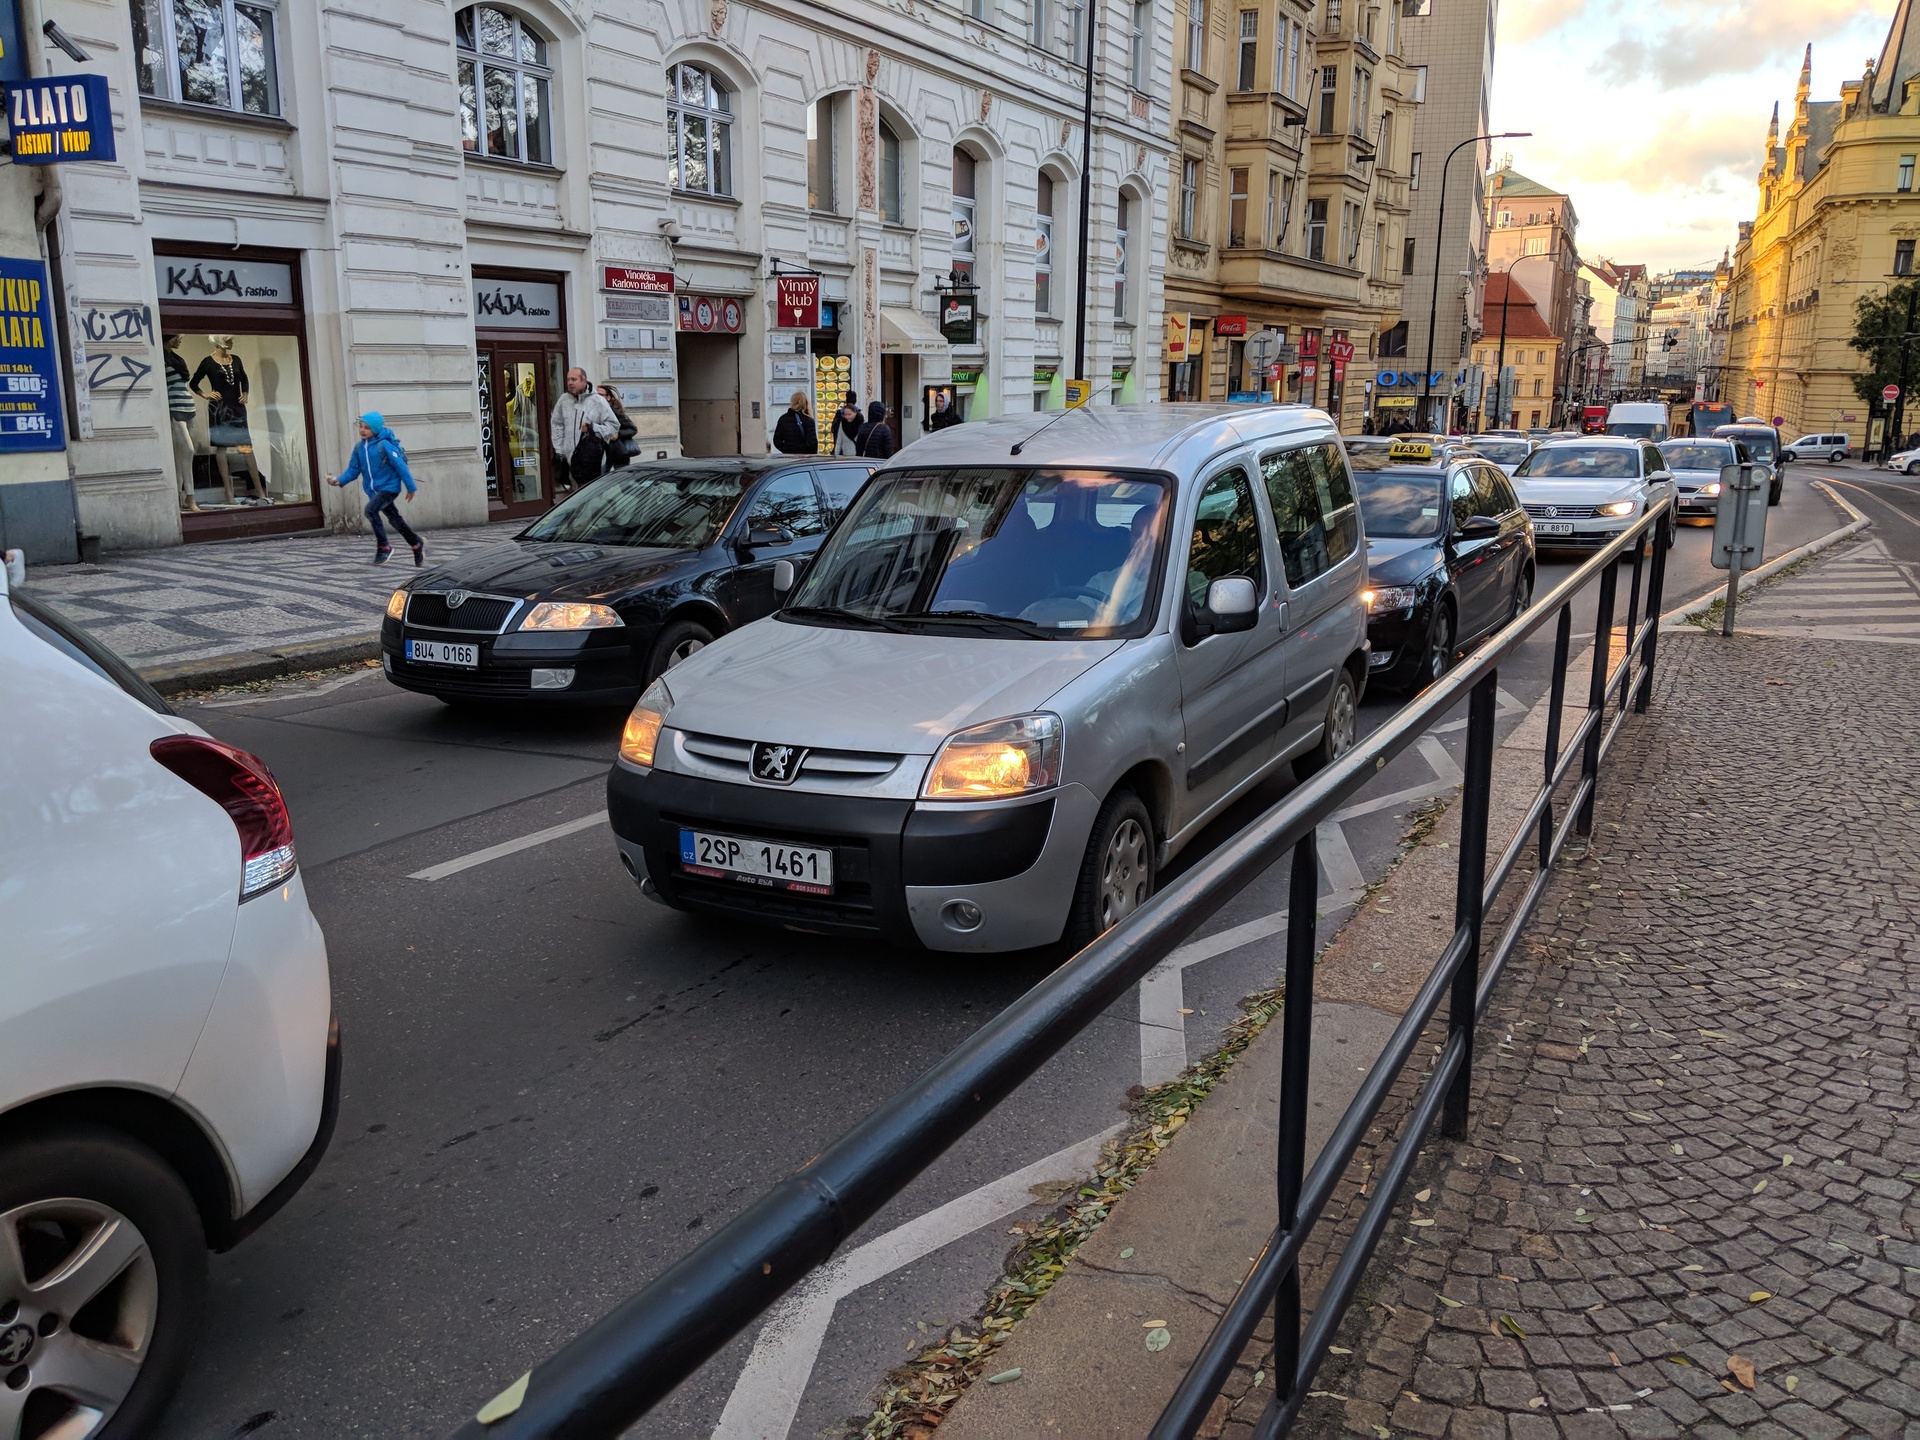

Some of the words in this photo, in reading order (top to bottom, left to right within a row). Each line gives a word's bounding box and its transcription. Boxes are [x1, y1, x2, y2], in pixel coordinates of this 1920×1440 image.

[12, 85, 88, 126] ZLATO
[16, 131, 52, 155] ZÁSTAVY
[62, 128, 91, 152] VÝKUP
[168, 263, 243, 297] KÁJA
[245, 286, 278, 297] fashion
[625, 270, 656, 281] Vinotéka
[612, 279, 640, 289] Karlovo
[641, 281, 669, 291] náměstí
[780, 279, 817, 294] Vinný
[478, 287, 527, 315] KÁJA
[528, 308, 550, 316] fashion
[785, 294, 812, 306] klub
[1333, 343, 1352, 356] TV
[1304, 366, 1316, 377] SHOP
[7, 377, 41, 391] 500
[16, 416, 46, 430] 641
[478, 364, 492, 471] KALHOTY
[1396, 445, 1425, 453] TAXI
[414, 643, 434, 659] 8U4
[443, 645, 472, 663] 0166
[684, 851, 694, 860] CZ
[700, 837, 741, 867] 2SP
[761, 847, 818, 880] 1461
[735, 874, 756, 884] Auto
[757, 878, 774, 887] ESA
